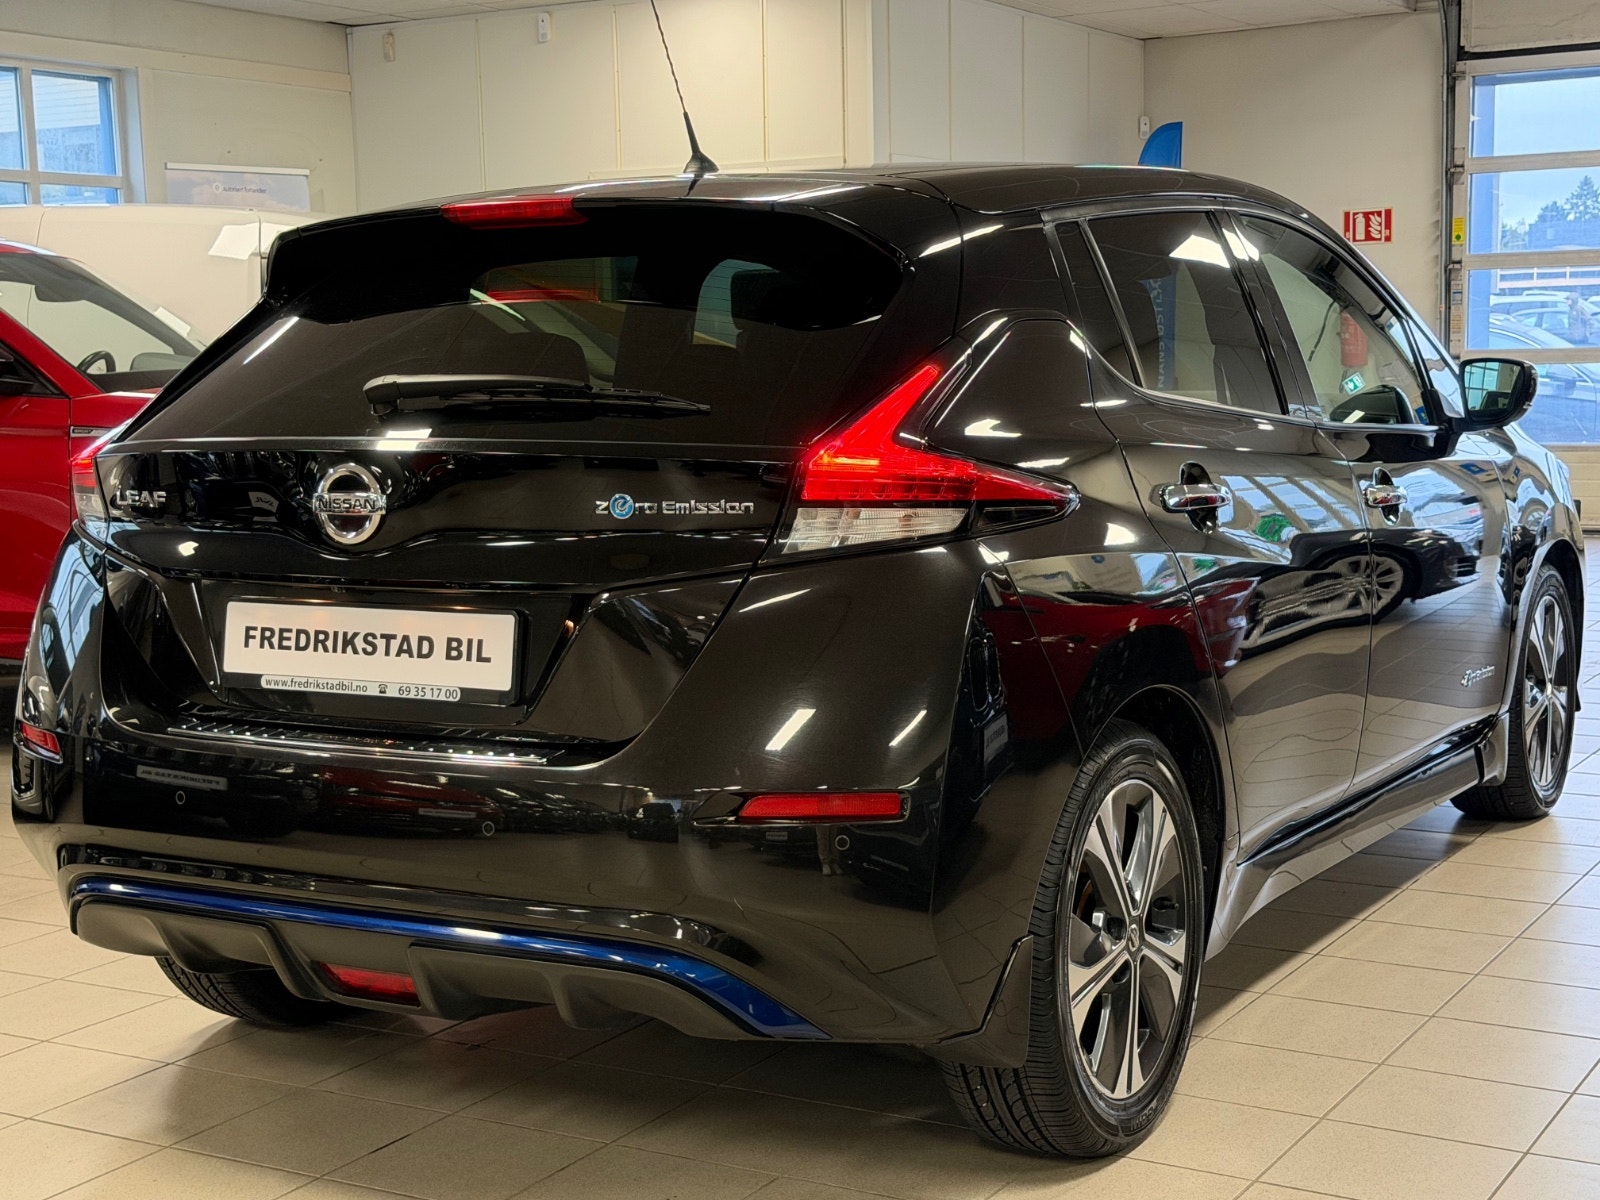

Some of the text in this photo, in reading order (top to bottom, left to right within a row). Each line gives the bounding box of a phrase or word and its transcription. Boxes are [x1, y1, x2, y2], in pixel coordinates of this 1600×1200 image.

[115, 485, 167, 507] LEAF
[317, 496, 378, 511] NISSAN
[662, 498, 754, 515] Emission
[243, 625, 492, 663] FREDRIKSTAD BIL
[264, 676, 458, 699] www.fredrikstadbil.no 69 35 17 00
